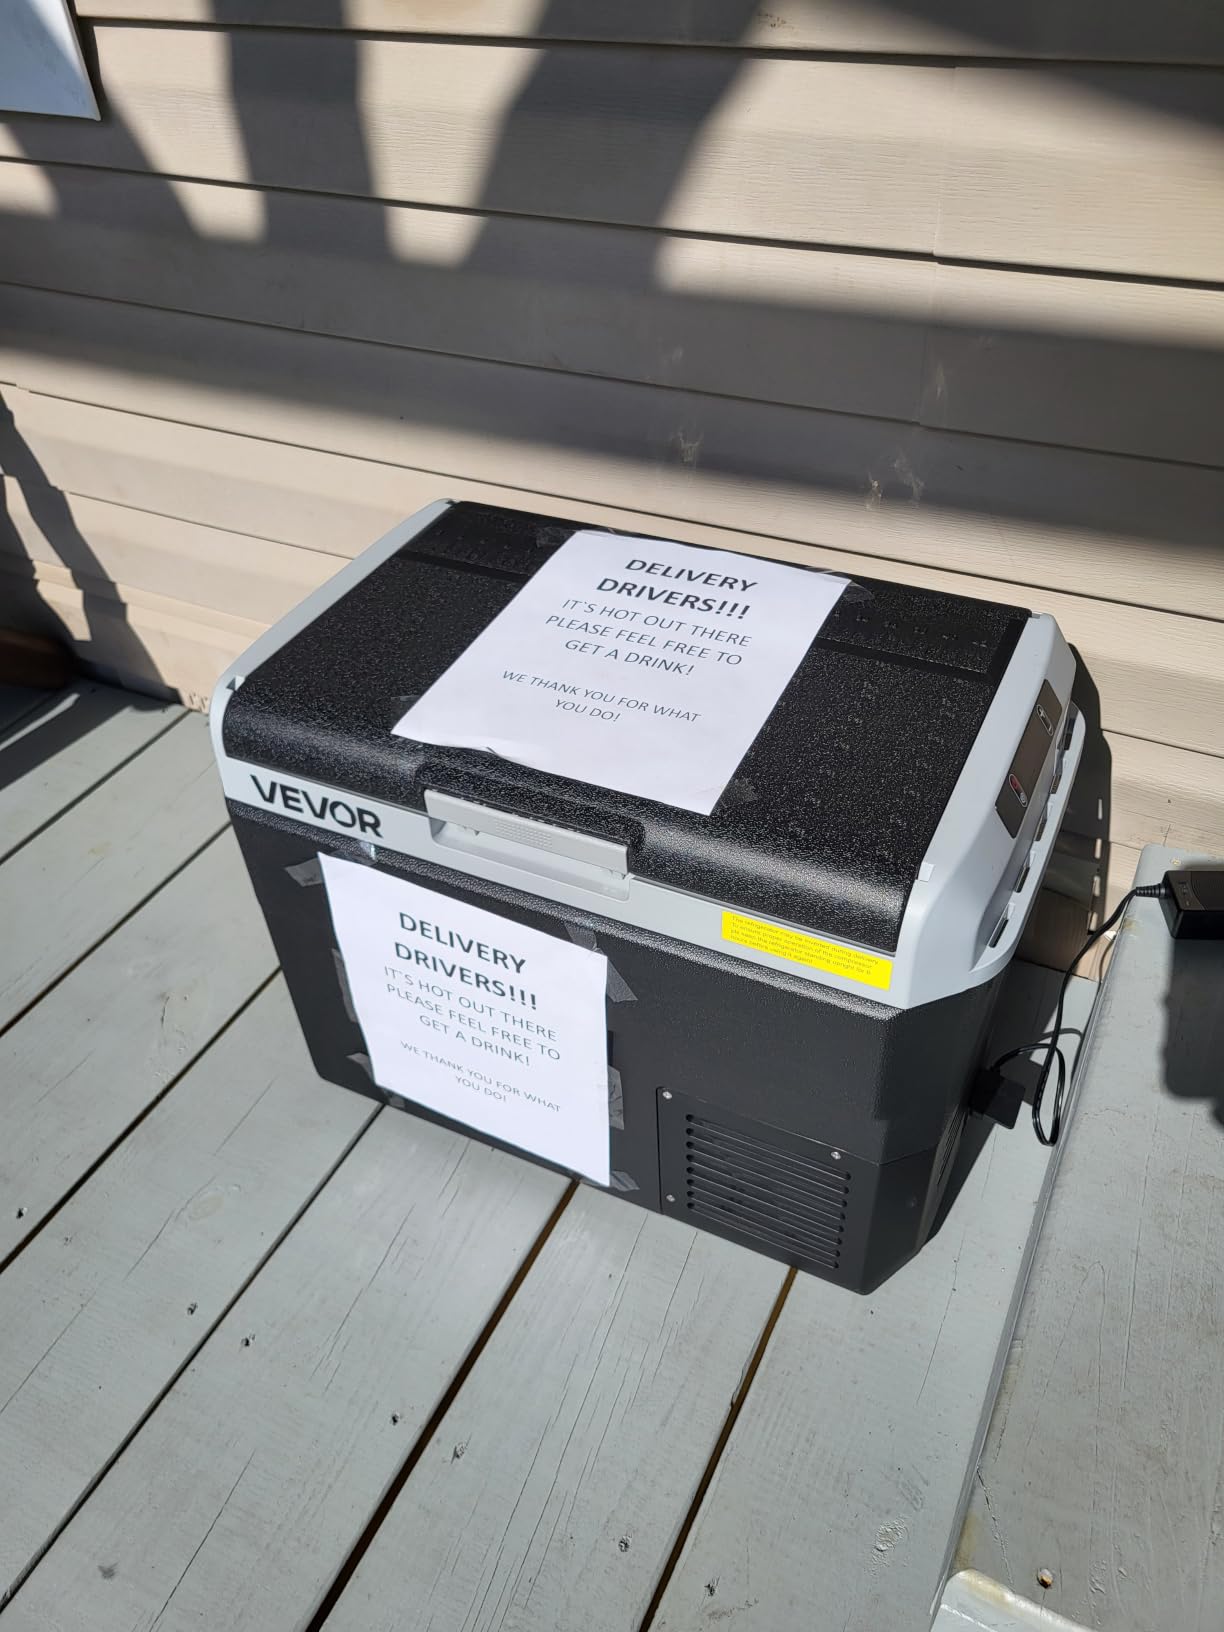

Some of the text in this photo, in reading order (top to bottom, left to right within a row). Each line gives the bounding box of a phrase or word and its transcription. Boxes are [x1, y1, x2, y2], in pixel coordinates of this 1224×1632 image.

[596, 577, 750, 619] DRIVERS!!!
[624, 559, 757, 591] DELIVERY
[545, 615, 742, 664] PLEASE FEEL FREE TO
[599, 606, 641, 621] HOT
[643, 615, 686, 631] OUT
[691, 624, 751, 646] THERE
[564, 639, 694, 675] GET A DRINK!
[502, 670, 701, 721] WE THANK YOU FOR WHAT
[555, 698, 620, 722] YOU DO!
[250, 774, 383, 838] VEVOR
[399, 911, 525, 973] DELIVERY
[394, 941, 536, 1010] DRIVERS!!!
[386, 983, 560, 1060] PLEASE FEEL FREE TO
[418, 979, 452, 1000] HOT
[458, 996, 494, 1017] OUT
[499, 1010, 556, 1041] THERE
[419, 1014, 529, 1066] GET A DRINK!
[400, 1040, 560, 1112] WE THANK YOU FOR WHAT
[455, 1075, 506, 1102] YOU DO!
